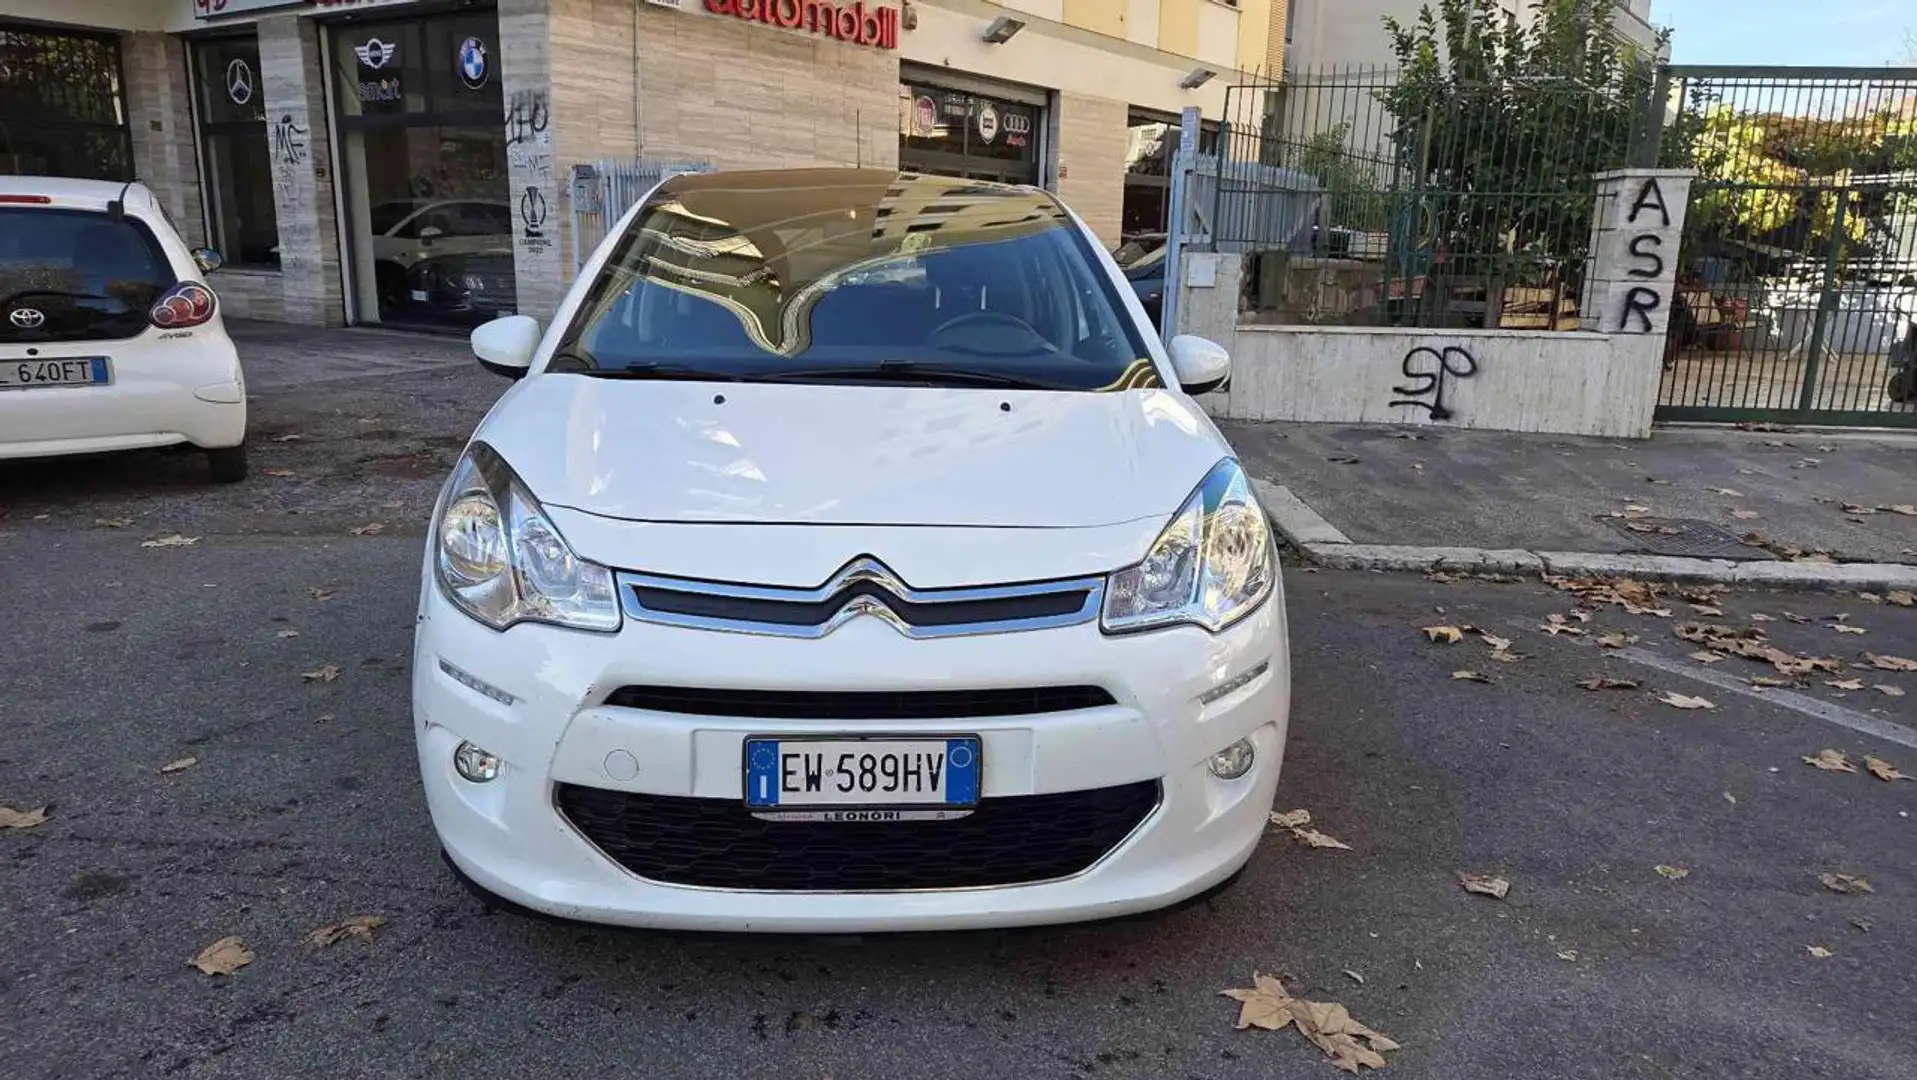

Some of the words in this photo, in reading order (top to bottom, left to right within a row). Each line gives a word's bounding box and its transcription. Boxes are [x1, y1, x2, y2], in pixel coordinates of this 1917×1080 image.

[18, 361, 89, 383] 640FT
[781, 753, 823, 793] EW
[836, 753, 944, 793] 589HV
[825, 810, 900, 821] LEONORI
